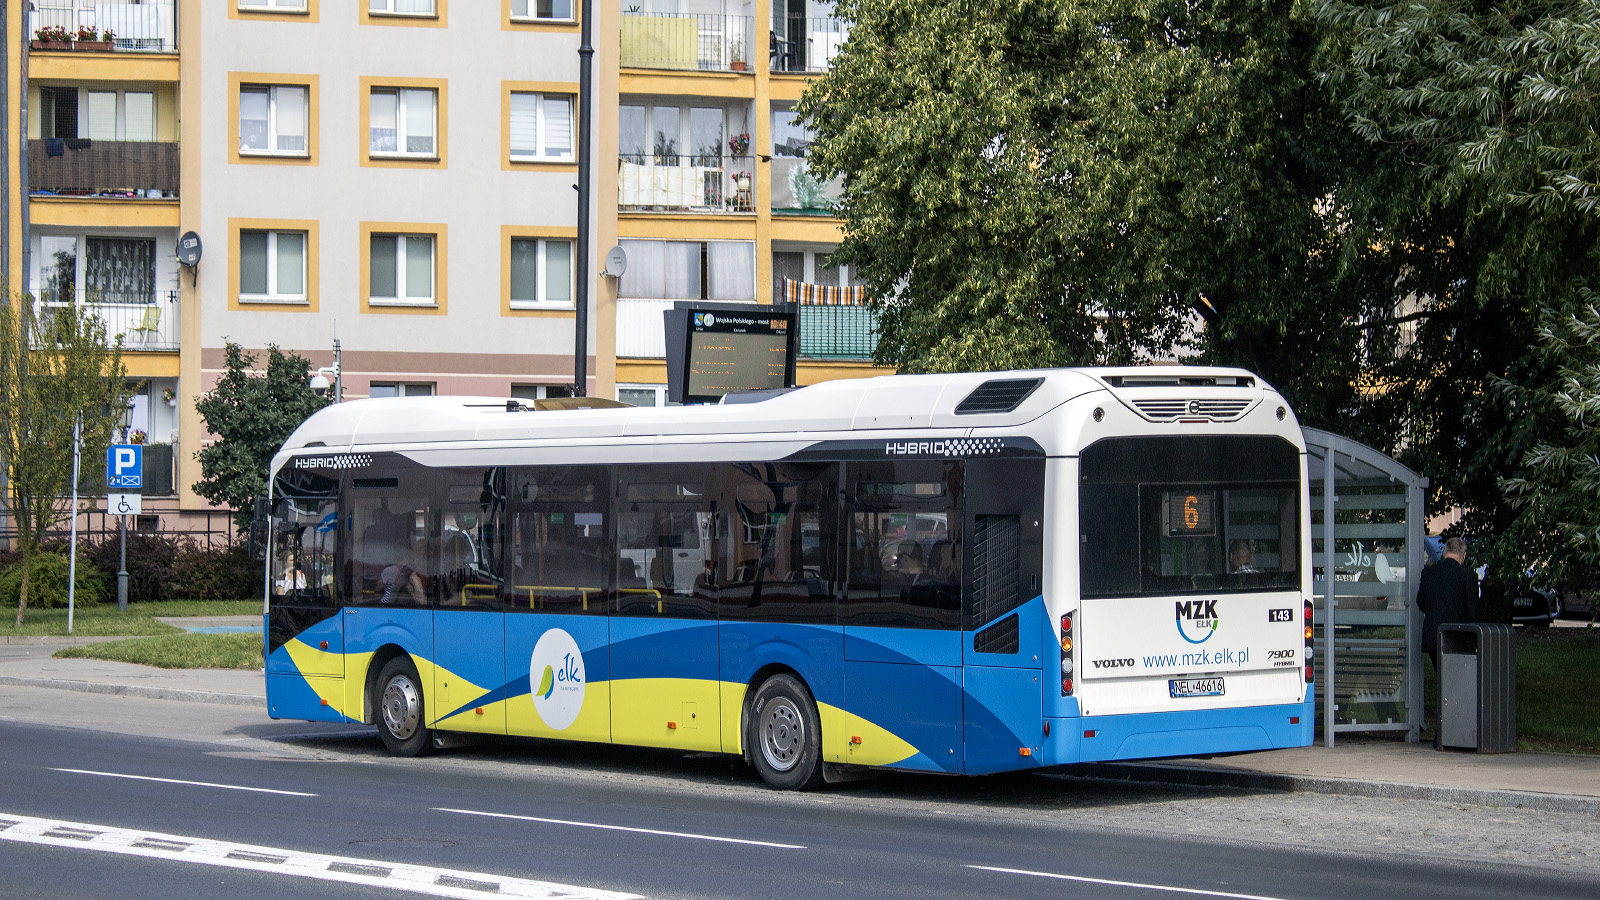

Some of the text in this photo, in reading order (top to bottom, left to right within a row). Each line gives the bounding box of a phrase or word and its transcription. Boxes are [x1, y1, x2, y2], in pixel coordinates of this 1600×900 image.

[886, 442, 944, 454] HYBRID
[116, 448, 136, 475] P
[295, 458, 334, 468] HYBRID
[1184, 496, 1198, 528] 6
[1176, 600, 1218, 620] MZK
[1272, 610, 1290, 622] 143
[1196, 620, 1212, 628] EŁK
[1143, 647, 1250, 669] www.mzk.elk.pl
[1268, 650, 1294, 660] 7900
[558, 652, 581, 682] elk
[1092, 658, 1135, 669] VOLVO
[1174, 680, 1222, 693] NEL 46616
